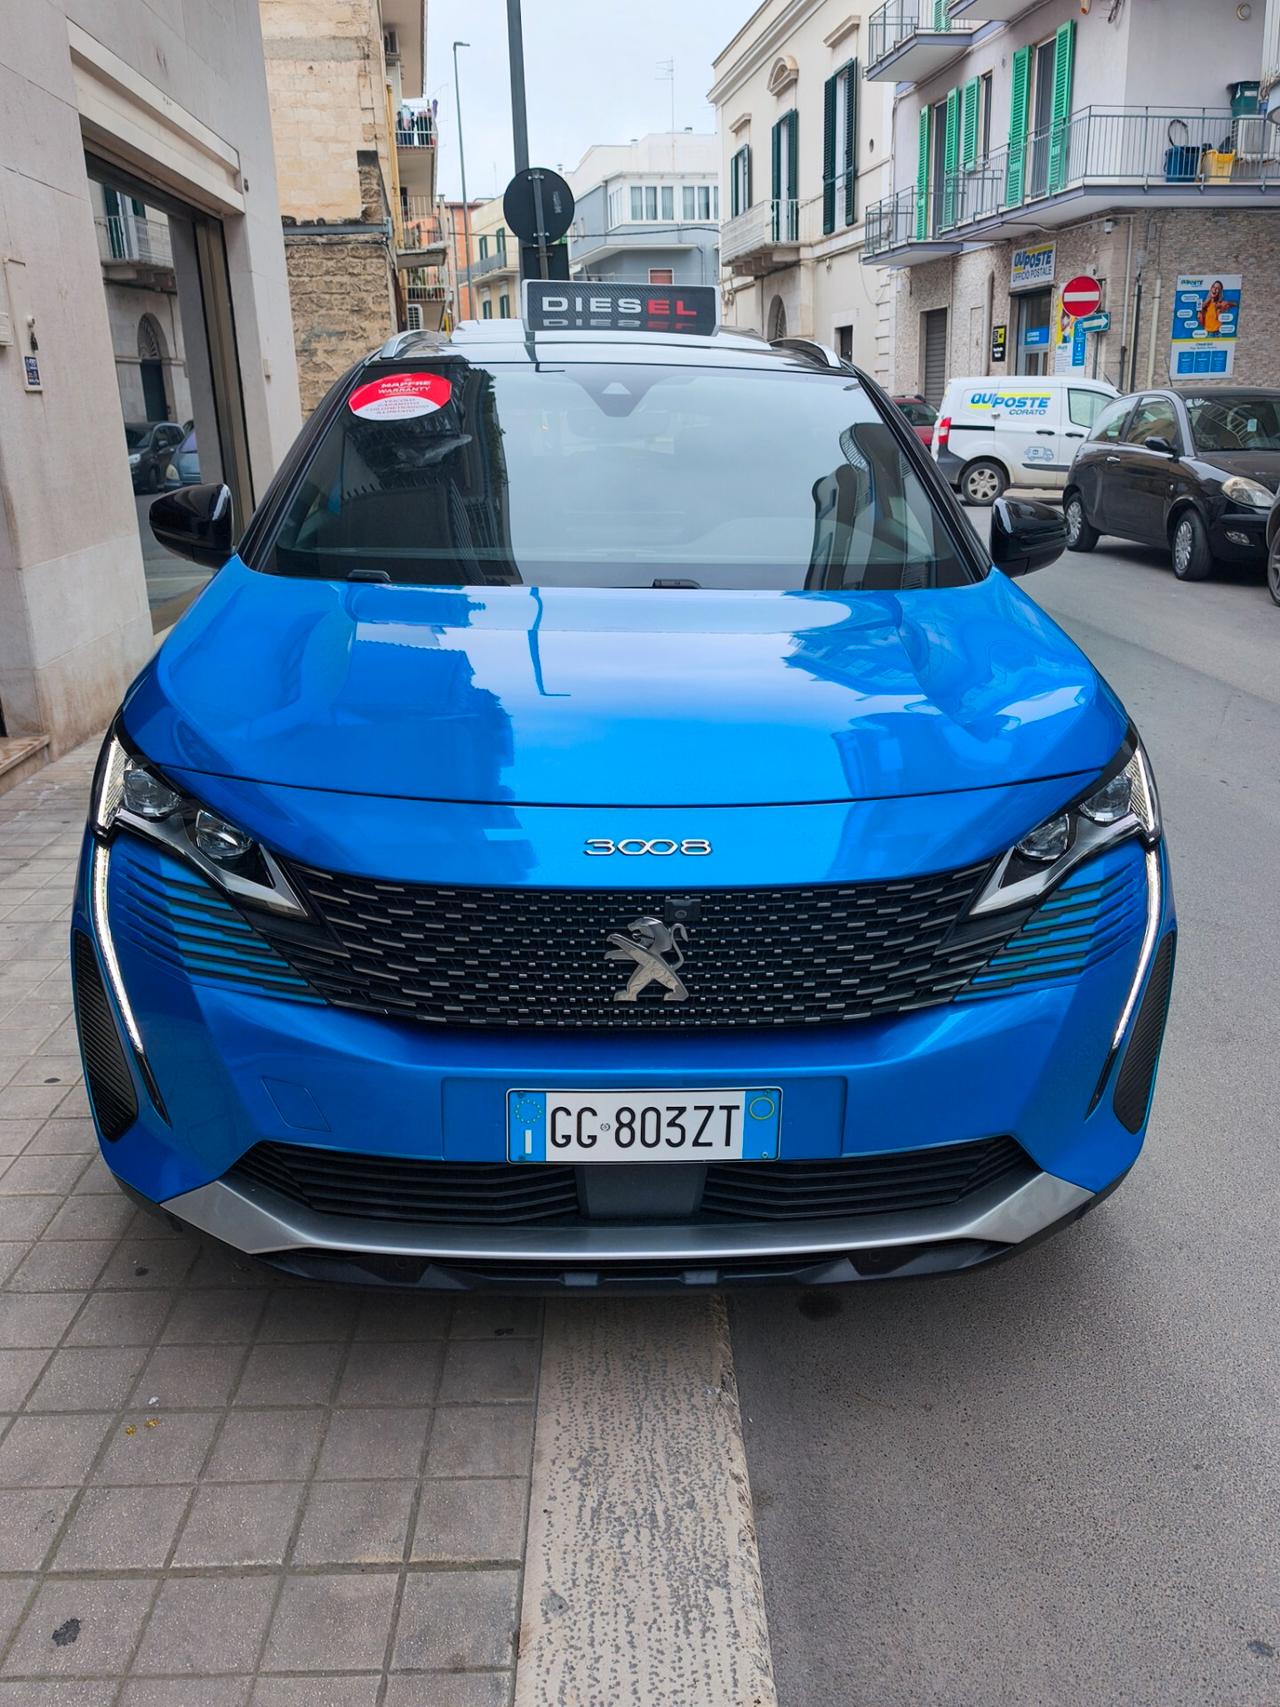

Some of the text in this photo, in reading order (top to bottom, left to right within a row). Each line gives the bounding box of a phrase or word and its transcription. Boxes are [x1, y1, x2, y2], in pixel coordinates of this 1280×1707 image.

[1012, 265, 1053, 282] UFFICIO POSTALE
[541, 296, 698, 316] DIESEL
[378, 386, 431, 394] WARRANTY
[380, 380, 432, 389] MAPFRE
[1008, 408, 1047, 416] CORATO
[583, 837, 713, 857] 3008
